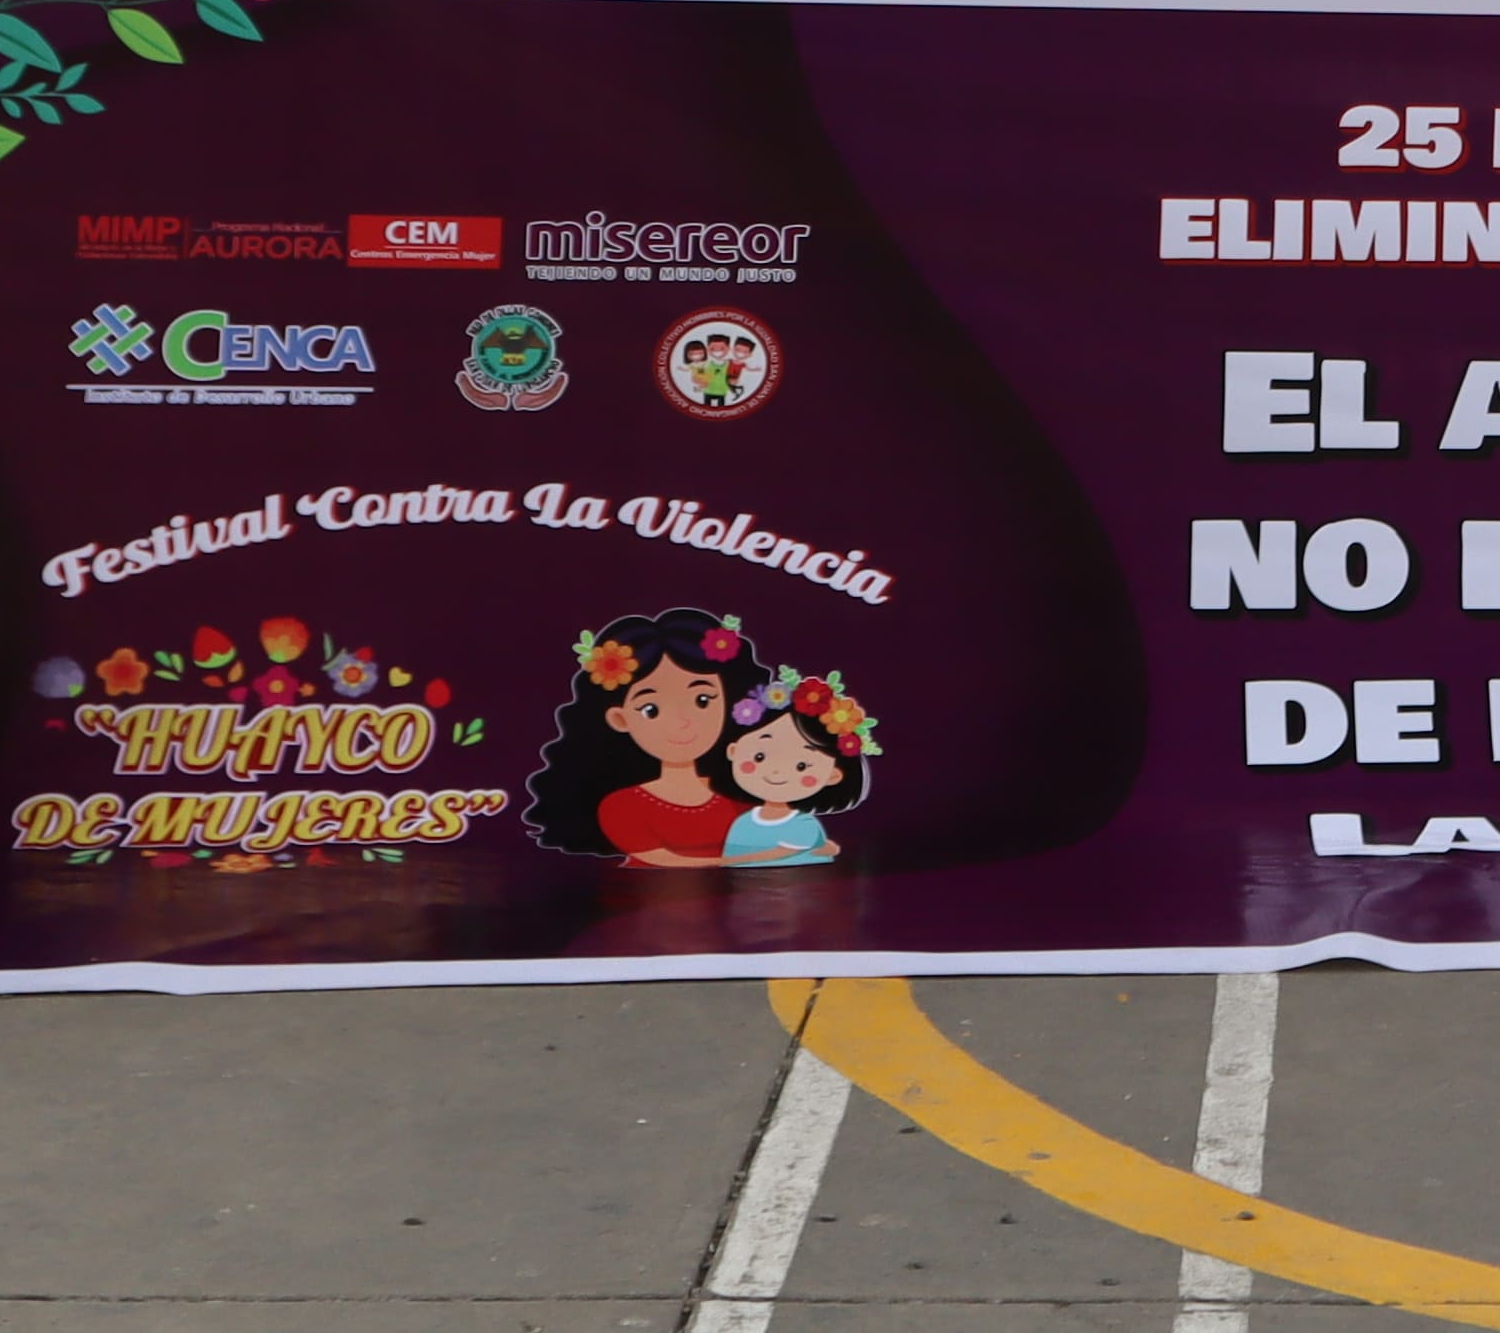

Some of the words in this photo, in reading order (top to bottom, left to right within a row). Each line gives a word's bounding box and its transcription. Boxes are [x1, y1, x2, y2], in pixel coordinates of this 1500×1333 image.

[1338, 106, 1463, 169] 25
[76, 214, 181, 245] MIMP
[384, 219, 459, 245] CEM
[525, 209, 810, 266] misereor
[189, 232, 342, 261] AURORA
[525, 265, 618, 283] TEJIENDO
[624, 266, 652, 282] UN
[658, 266, 730, 283] MUNDO
[737, 267, 798, 284] JUSTO
[162, 309, 376, 382] CENCA
[1221, 350, 1402, 453] EL
[41, 494, 291, 601] Festival
[295, 482, 515, 537] Contra
[523, 481, 609, 532] La
[617, 496, 894, 606] Violencia
[1189, 517, 1412, 612] NO
[1243, 677, 1441, 765] DE
[12, 792, 121, 852] DE
